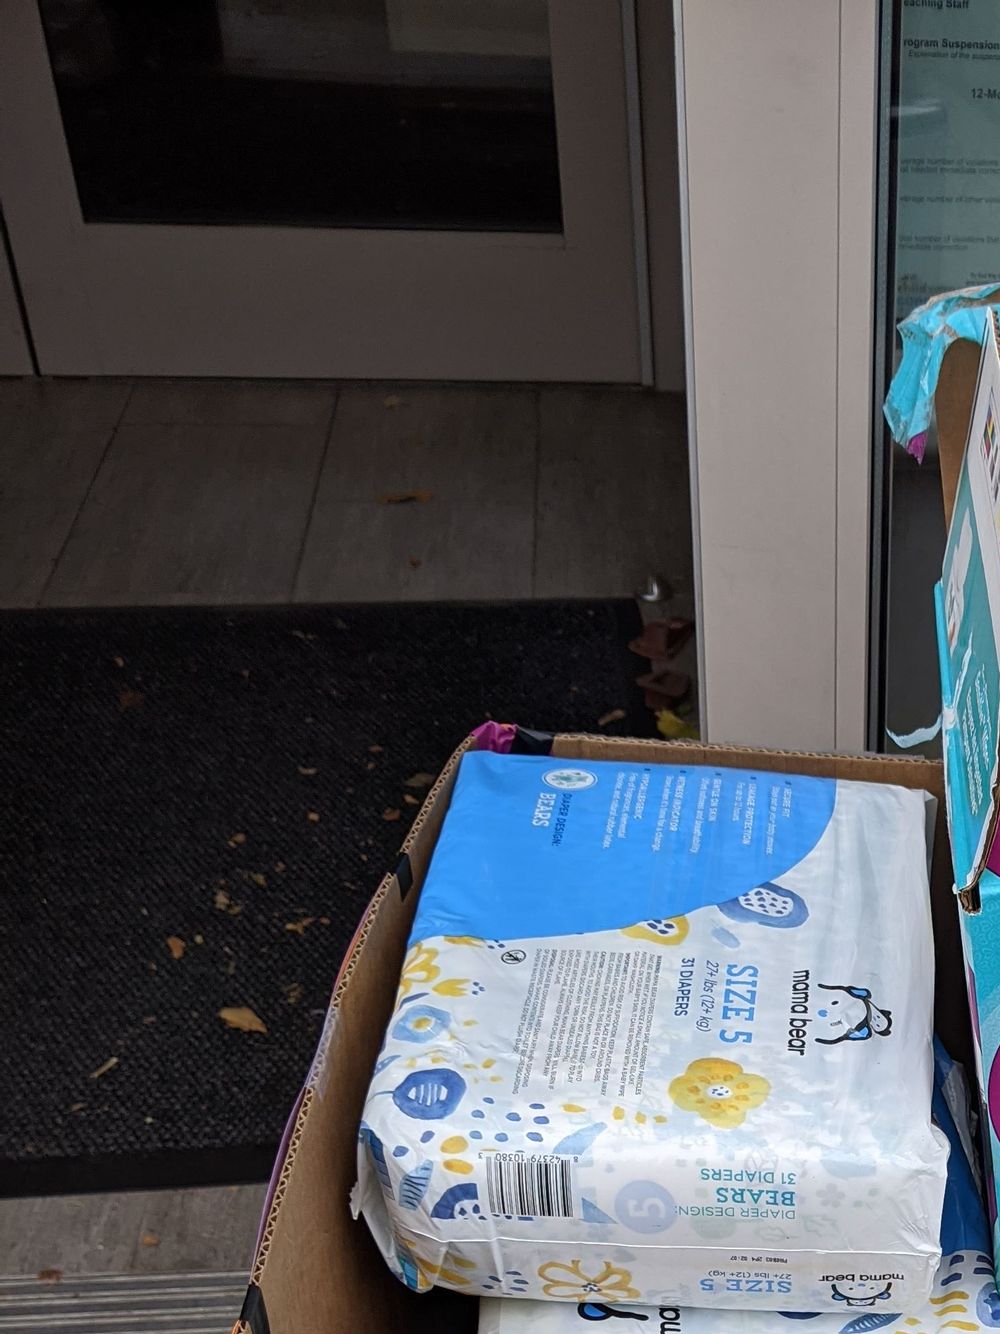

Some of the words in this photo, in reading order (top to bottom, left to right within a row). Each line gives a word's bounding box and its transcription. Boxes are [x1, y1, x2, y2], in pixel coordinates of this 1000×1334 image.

[903, 39, 939, 50] rogram
[531, 792, 557, 827] BEARS
[558, 793, 573, 815] DIAPER
[670, 799, 682, 832] INDICATOR
[552, 817, 567, 847] DESIGN:
[681, 957, 695, 968] 31
[706, 960, 719, 978] 27+
[703, 978, 718, 993] lbs
[722, 964, 759, 1022] SIZE
[791, 969, 811, 1014] mama
[674, 970, 693, 1017] DIAPERS
[700, 994, 715, 1014] (12+
[696, 1015, 713, 1032] kg)
[719, 1029, 753, 1044] 5
[787, 1018, 813, 1056] bear
[495, 1153, 525, 1162] 10380
[531, 1154, 561, 1164] 42379
[700, 1168, 775, 1184] DIAPERS
[780, 1173, 796, 1185] 31
[716, 1187, 796, 1207] BEARS
[674, 1205, 735, 1218] DESIGN:
[741, 1207, 796, 1219] DIAPER
[708, 1270, 726, 1278] kg)
[728, 1271, 751, 1279] (12+
[818, 1273, 855, 1284] bear
[859, 1272, 904, 1282] mama
[699, 1278, 714, 1292] 5
[726, 1279, 792, 1293] SIZE
